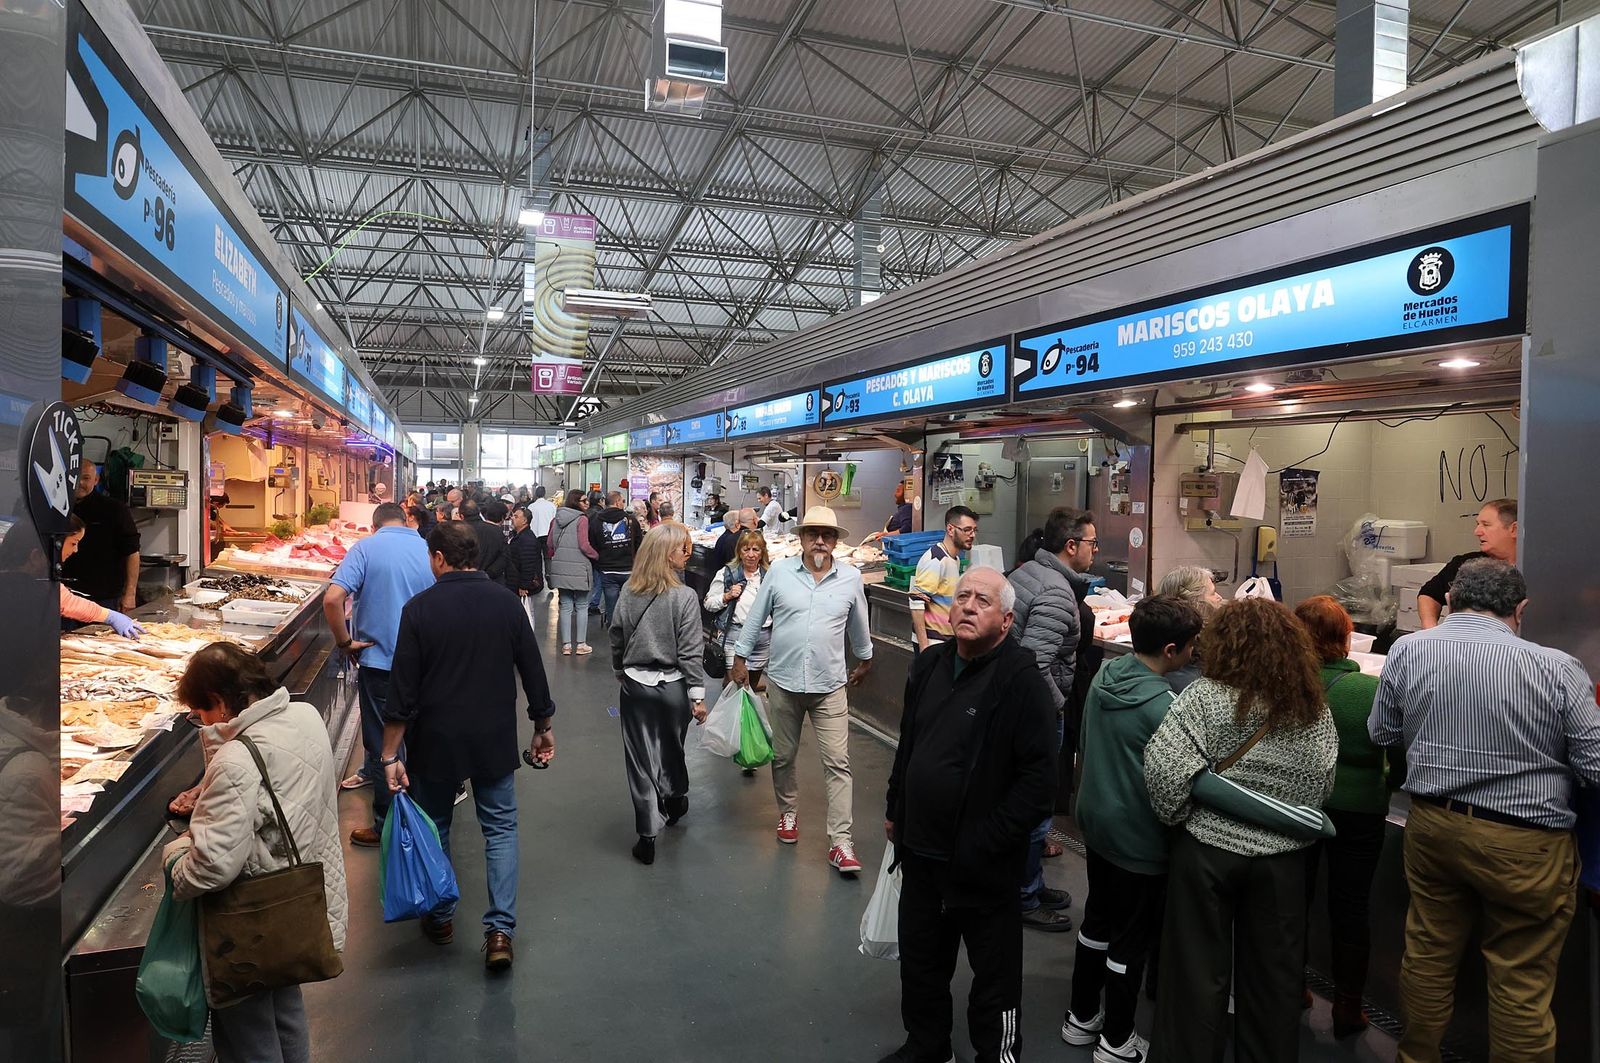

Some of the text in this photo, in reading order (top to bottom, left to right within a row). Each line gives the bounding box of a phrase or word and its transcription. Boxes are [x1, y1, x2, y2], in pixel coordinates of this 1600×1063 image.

[145, 158, 175, 205] Pescadería
[215, 223, 257, 297] ELIZABETH
[1117, 278, 1336, 347] MARISCOS OLAYA
[1403, 295, 1458, 312] Mercados
[1403, 305, 1458, 321] de Huelva
[1172, 330, 1254, 359] 959 243 430
[866, 356, 971, 394] PESCADOS Y MARISCOS
[892, 384, 934, 407] C. OLAYA
[53, 410, 82, 490] TICKET
